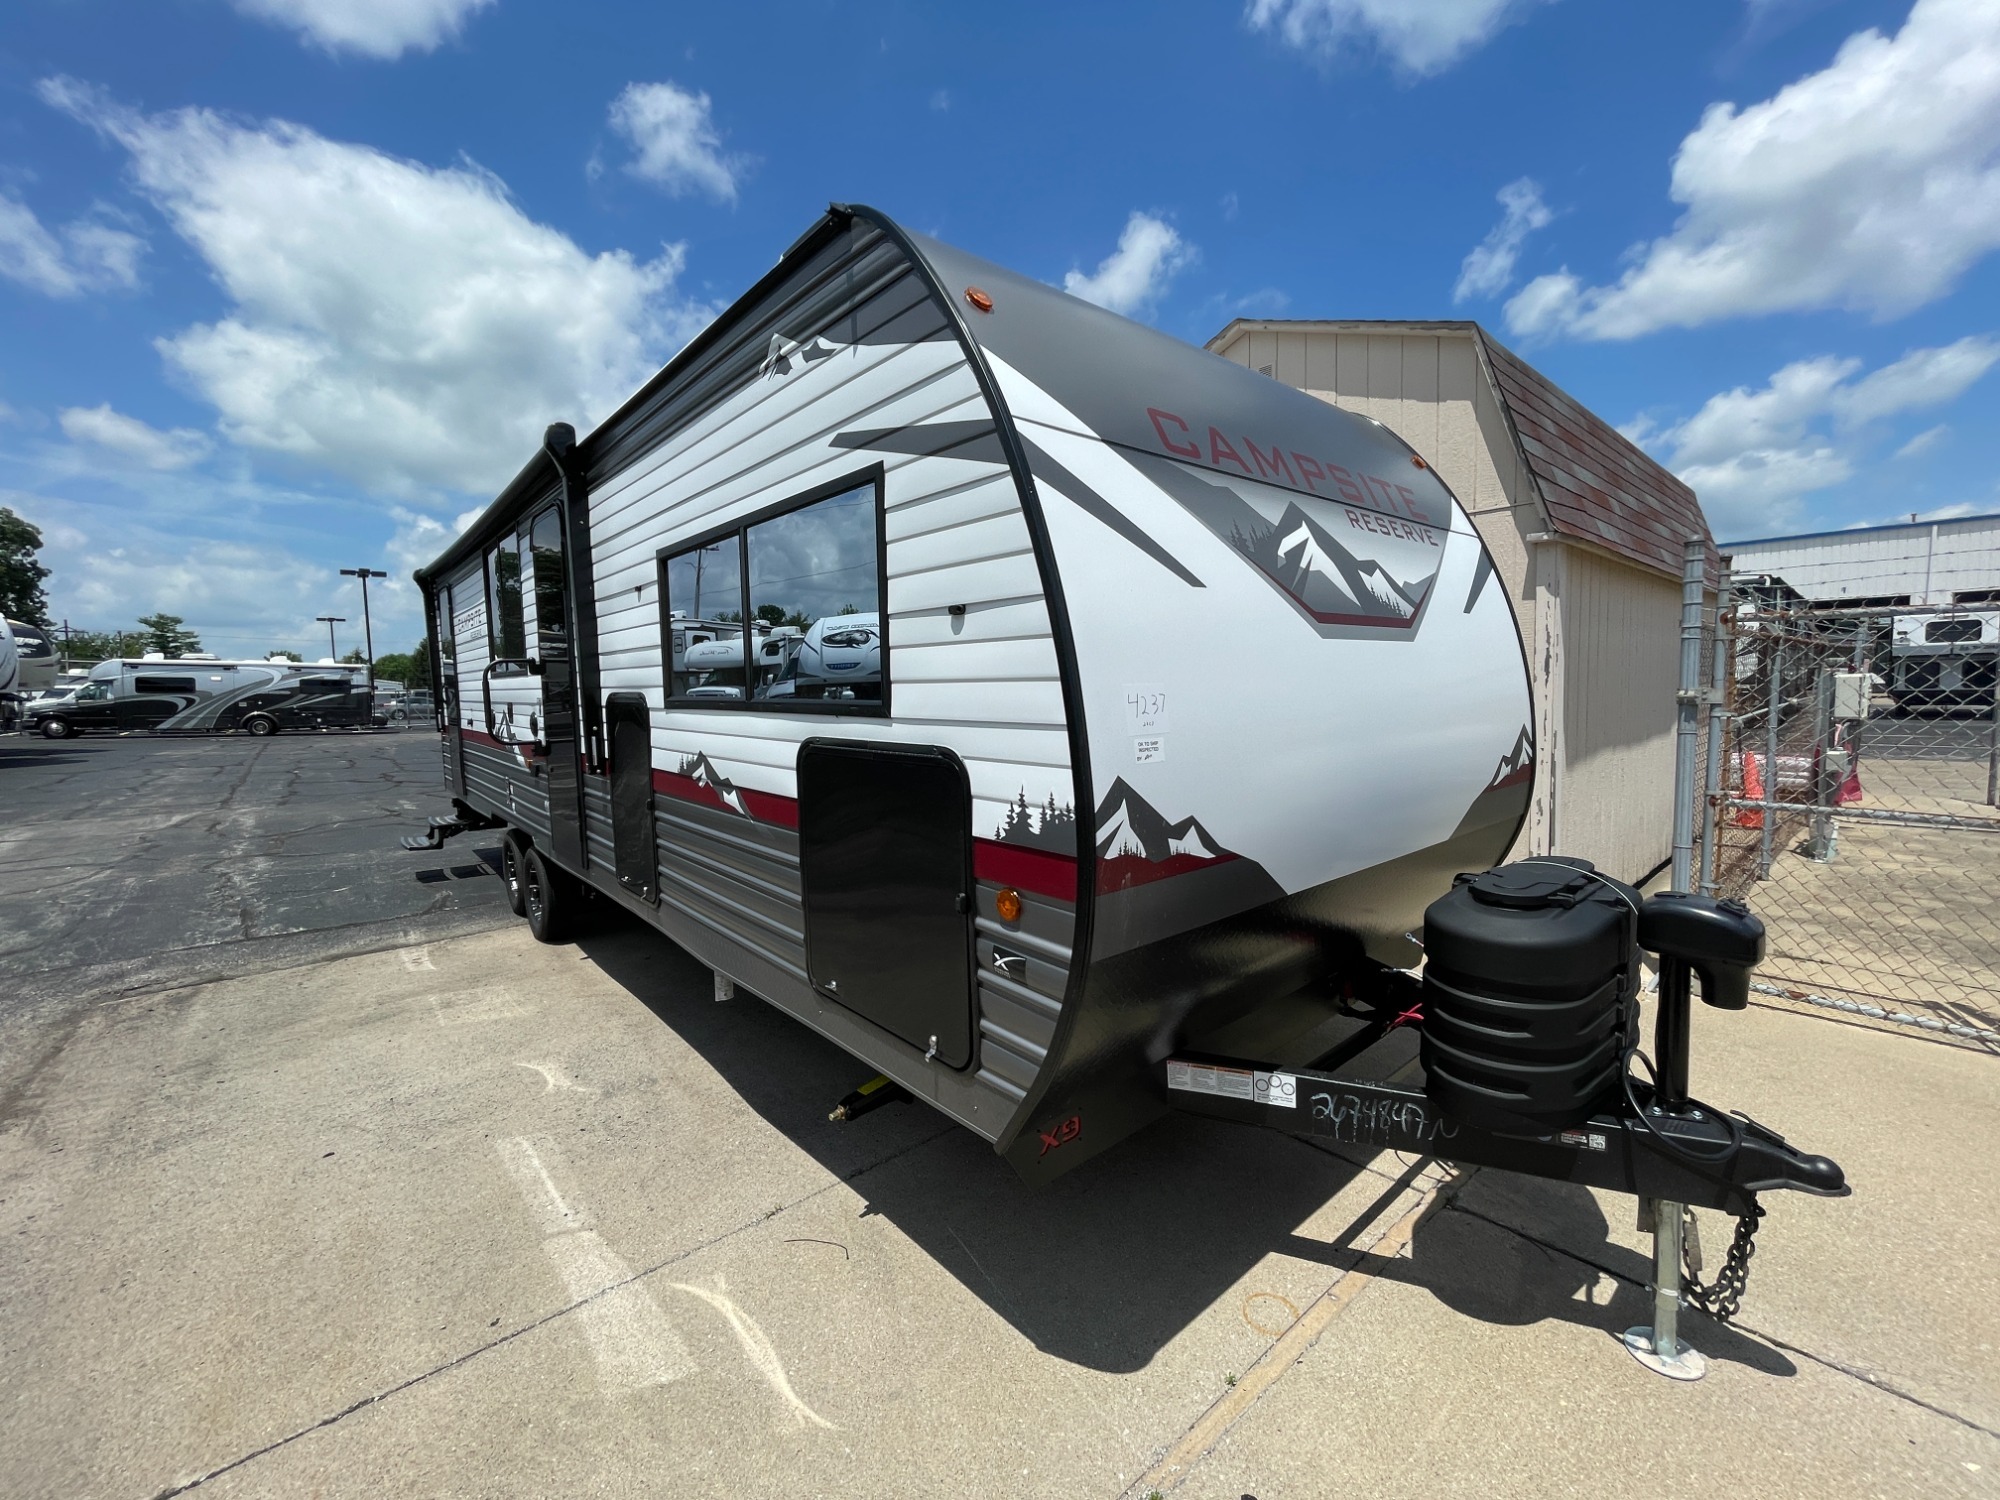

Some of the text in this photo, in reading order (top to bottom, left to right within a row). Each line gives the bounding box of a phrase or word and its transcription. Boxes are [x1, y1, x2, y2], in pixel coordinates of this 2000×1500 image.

[1146, 407, 1429, 520] CAMPSITE
[1345, 509, 1439, 547] RESERVE
[1127, 692, 1166, 718] 4237
